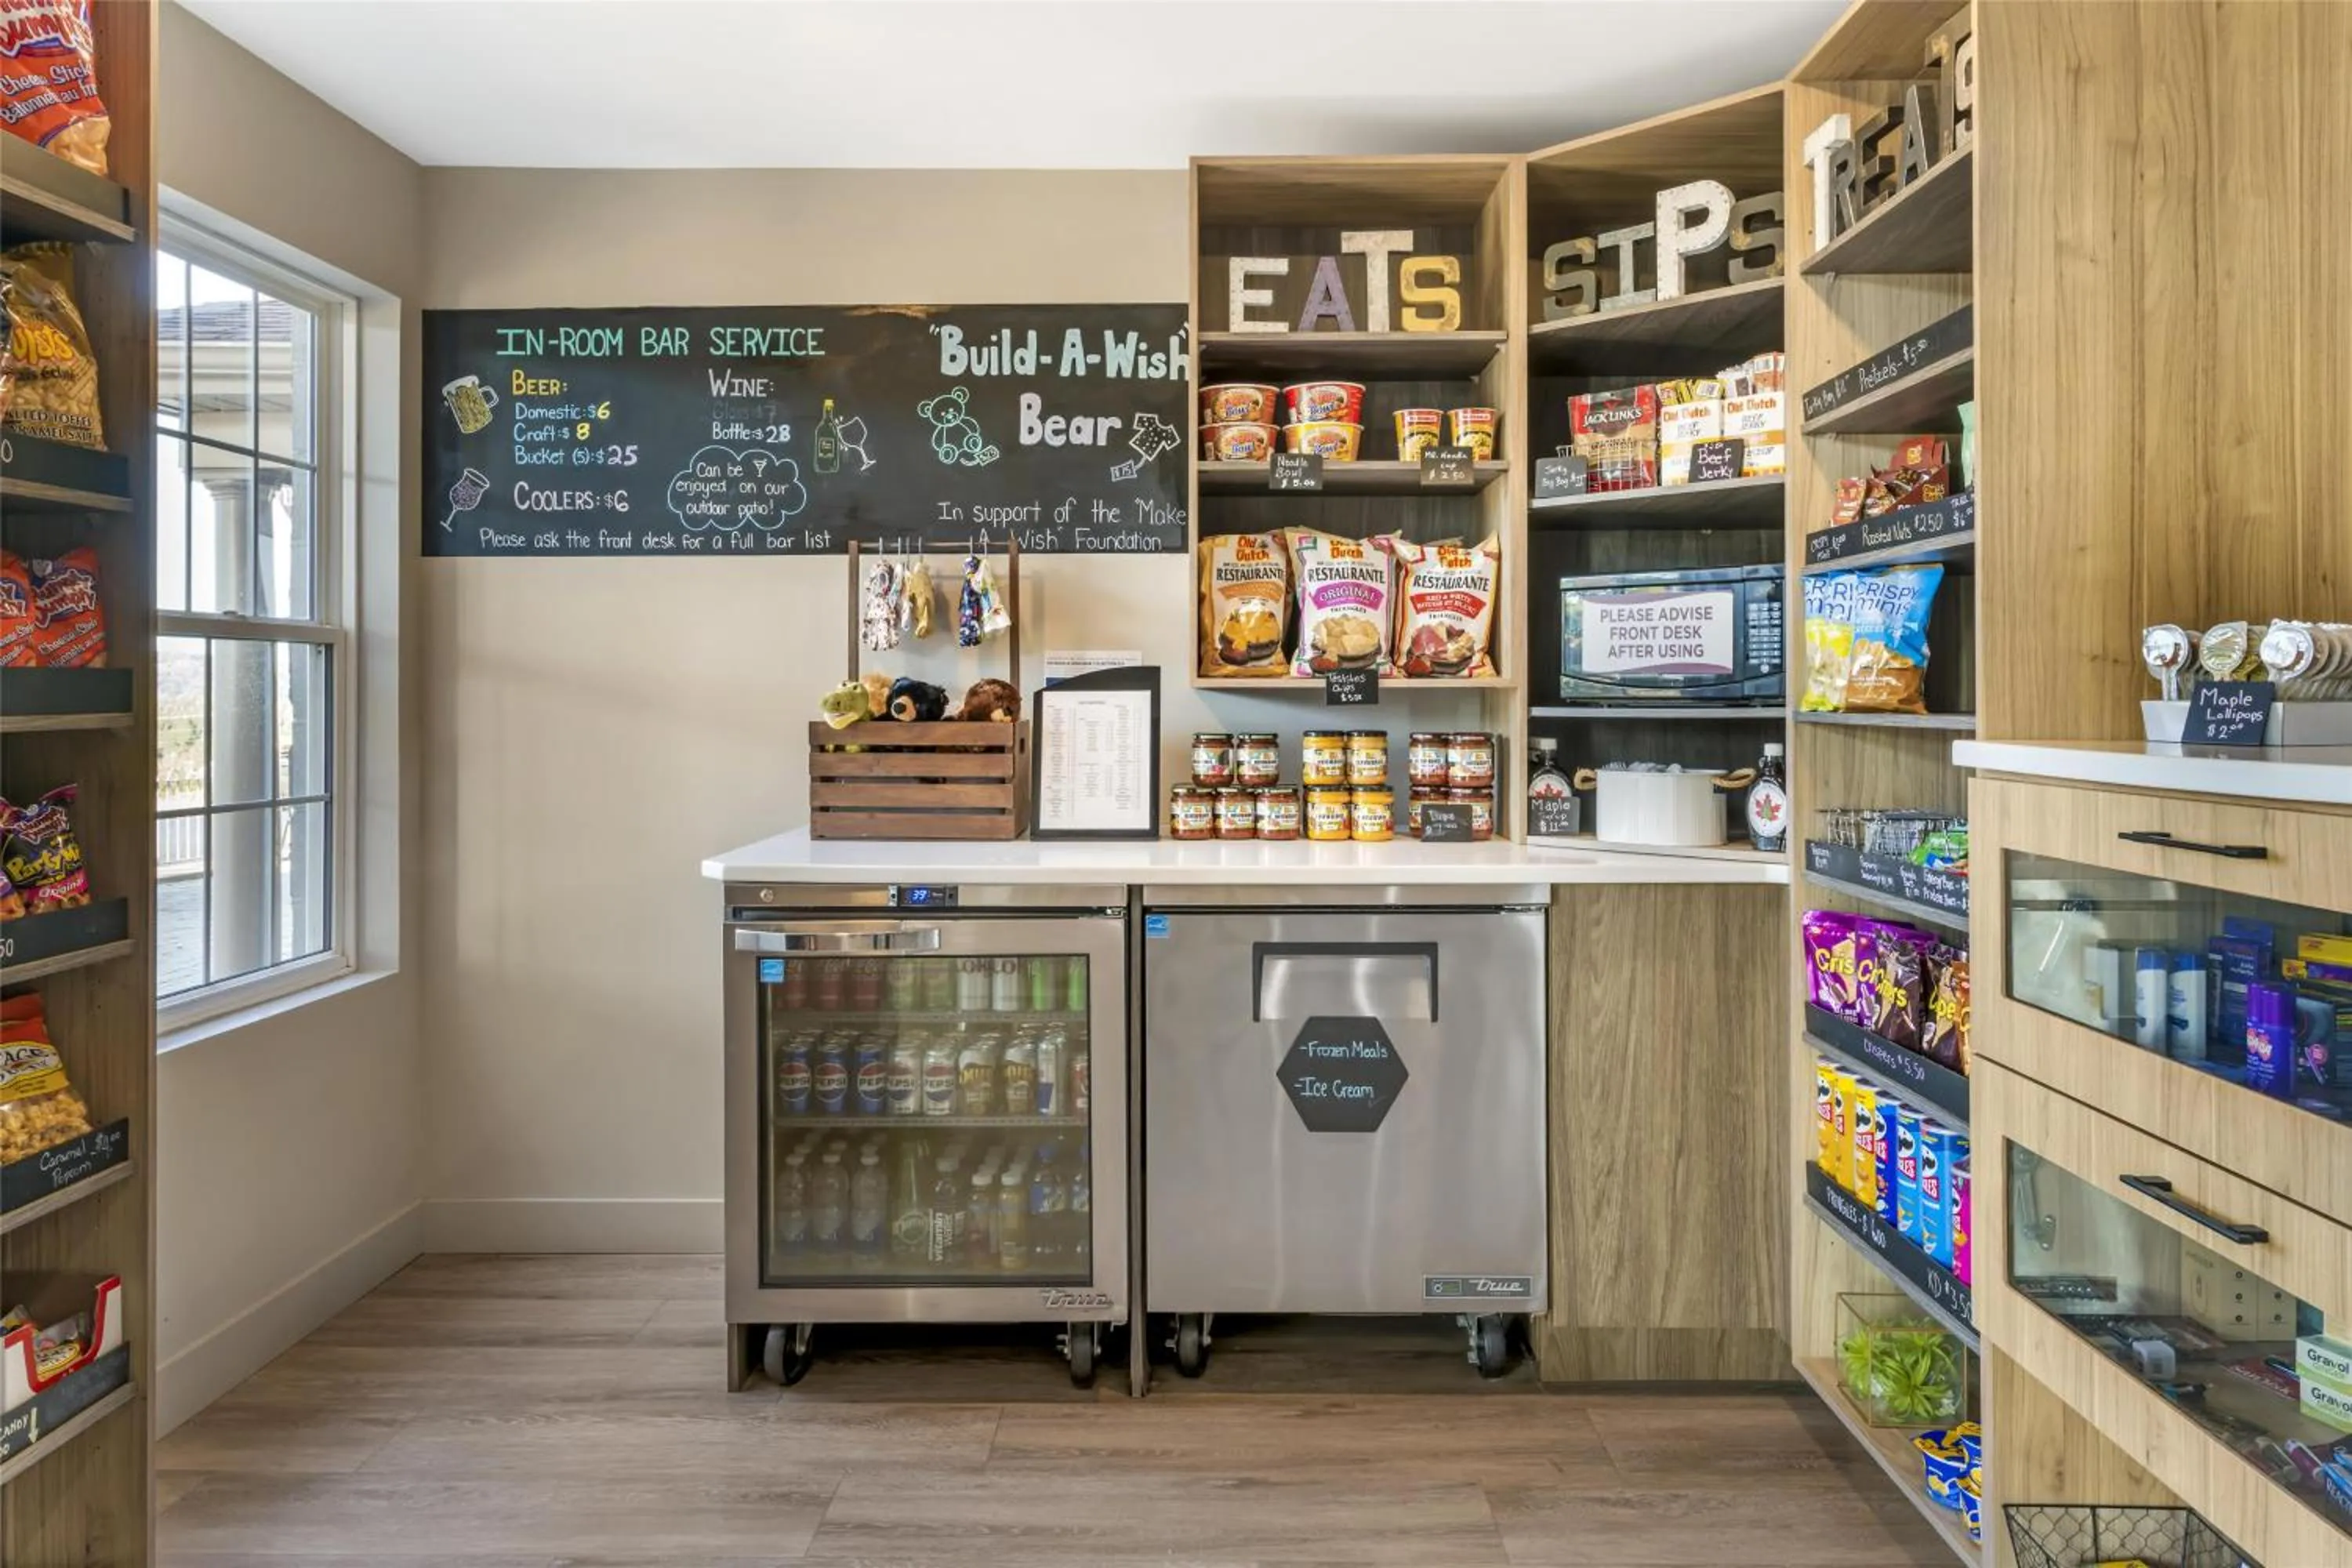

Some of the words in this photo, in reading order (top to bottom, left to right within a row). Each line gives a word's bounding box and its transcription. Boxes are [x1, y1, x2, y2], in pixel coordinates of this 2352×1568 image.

[1542, 180, 1784, 322] SIPS
[1229, 230, 1461, 333] EATS
[496, 328, 623, 356] IN-ROOM
[641, 328, 689, 355] BAR
[710, 327, 826, 356] SERVICE
[1019, 393, 1122, 446] Bear
[576, 423, 590, 441] 8
[1698, 448, 1732, 465] Beef
[697, 463, 720, 477] Can
[728, 462, 744, 477] be
[1276, 469, 1302, 479] Bowl
[1698, 466, 1733, 480] Jerky
[675, 480, 727, 499] enjoyed
[739, 482, 757, 494] on
[764, 484, 789, 495] our
[687, 499, 731, 515] outdoor
[938, 502, 964, 521] In
[973, 500, 1041, 528] support
[1054, 497, 1076, 523] of
[1091, 500, 1121, 523] the
[480, 527, 526, 548] Please
[534, 530, 560, 548] ask
[566, 528, 590, 548] the
[599, 530, 631, 549] front
[642, 531, 675, 548] desk
[682, 532, 705, 548] for
[713, 535, 724, 548] a
[731, 531, 753, 549] full
[767, 532, 796, 548] bar
[805, 528, 831, 548] list
[1075, 528, 1161, 551] Foundation
[1238, 536, 1258, 547] Old
[1236, 549, 1269, 561] Dutch
[1217, 568, 1284, 581] RESTAURANT
[1308, 567, 1385, 584] RESTAURANTE
[1413, 575, 1490, 592] RESTAURANTE
[1319, 586, 1377, 602] ORIGINAL
[1856, 580, 1920, 600] CRISPY
[1600, 608, 1654, 624] PLEASE
[1658, 605, 1714, 621] ADVISE
[1610, 626, 1658, 641] FRONT
[1663, 624, 1703, 640] DESK
[1608, 644, 1654, 659] AFTER
[1659, 643, 1704, 659] USING
[2199, 688, 2253, 707] Maple
[2206, 707, 2264, 722] Lollipops
[1531, 798, 1570, 814] Maple
[6, 850, 61, 881] Party
[1351, 1040, 1388, 1058] Meals
[1332, 1078, 1374, 1099] Cream
[40, 1138, 86, 1171] Caramel
[53, 1161, 92, 1188] Popcorn
[1468, 1278, 1524, 1291] True
[2307, 1348, 2350, 1375] Gravol
